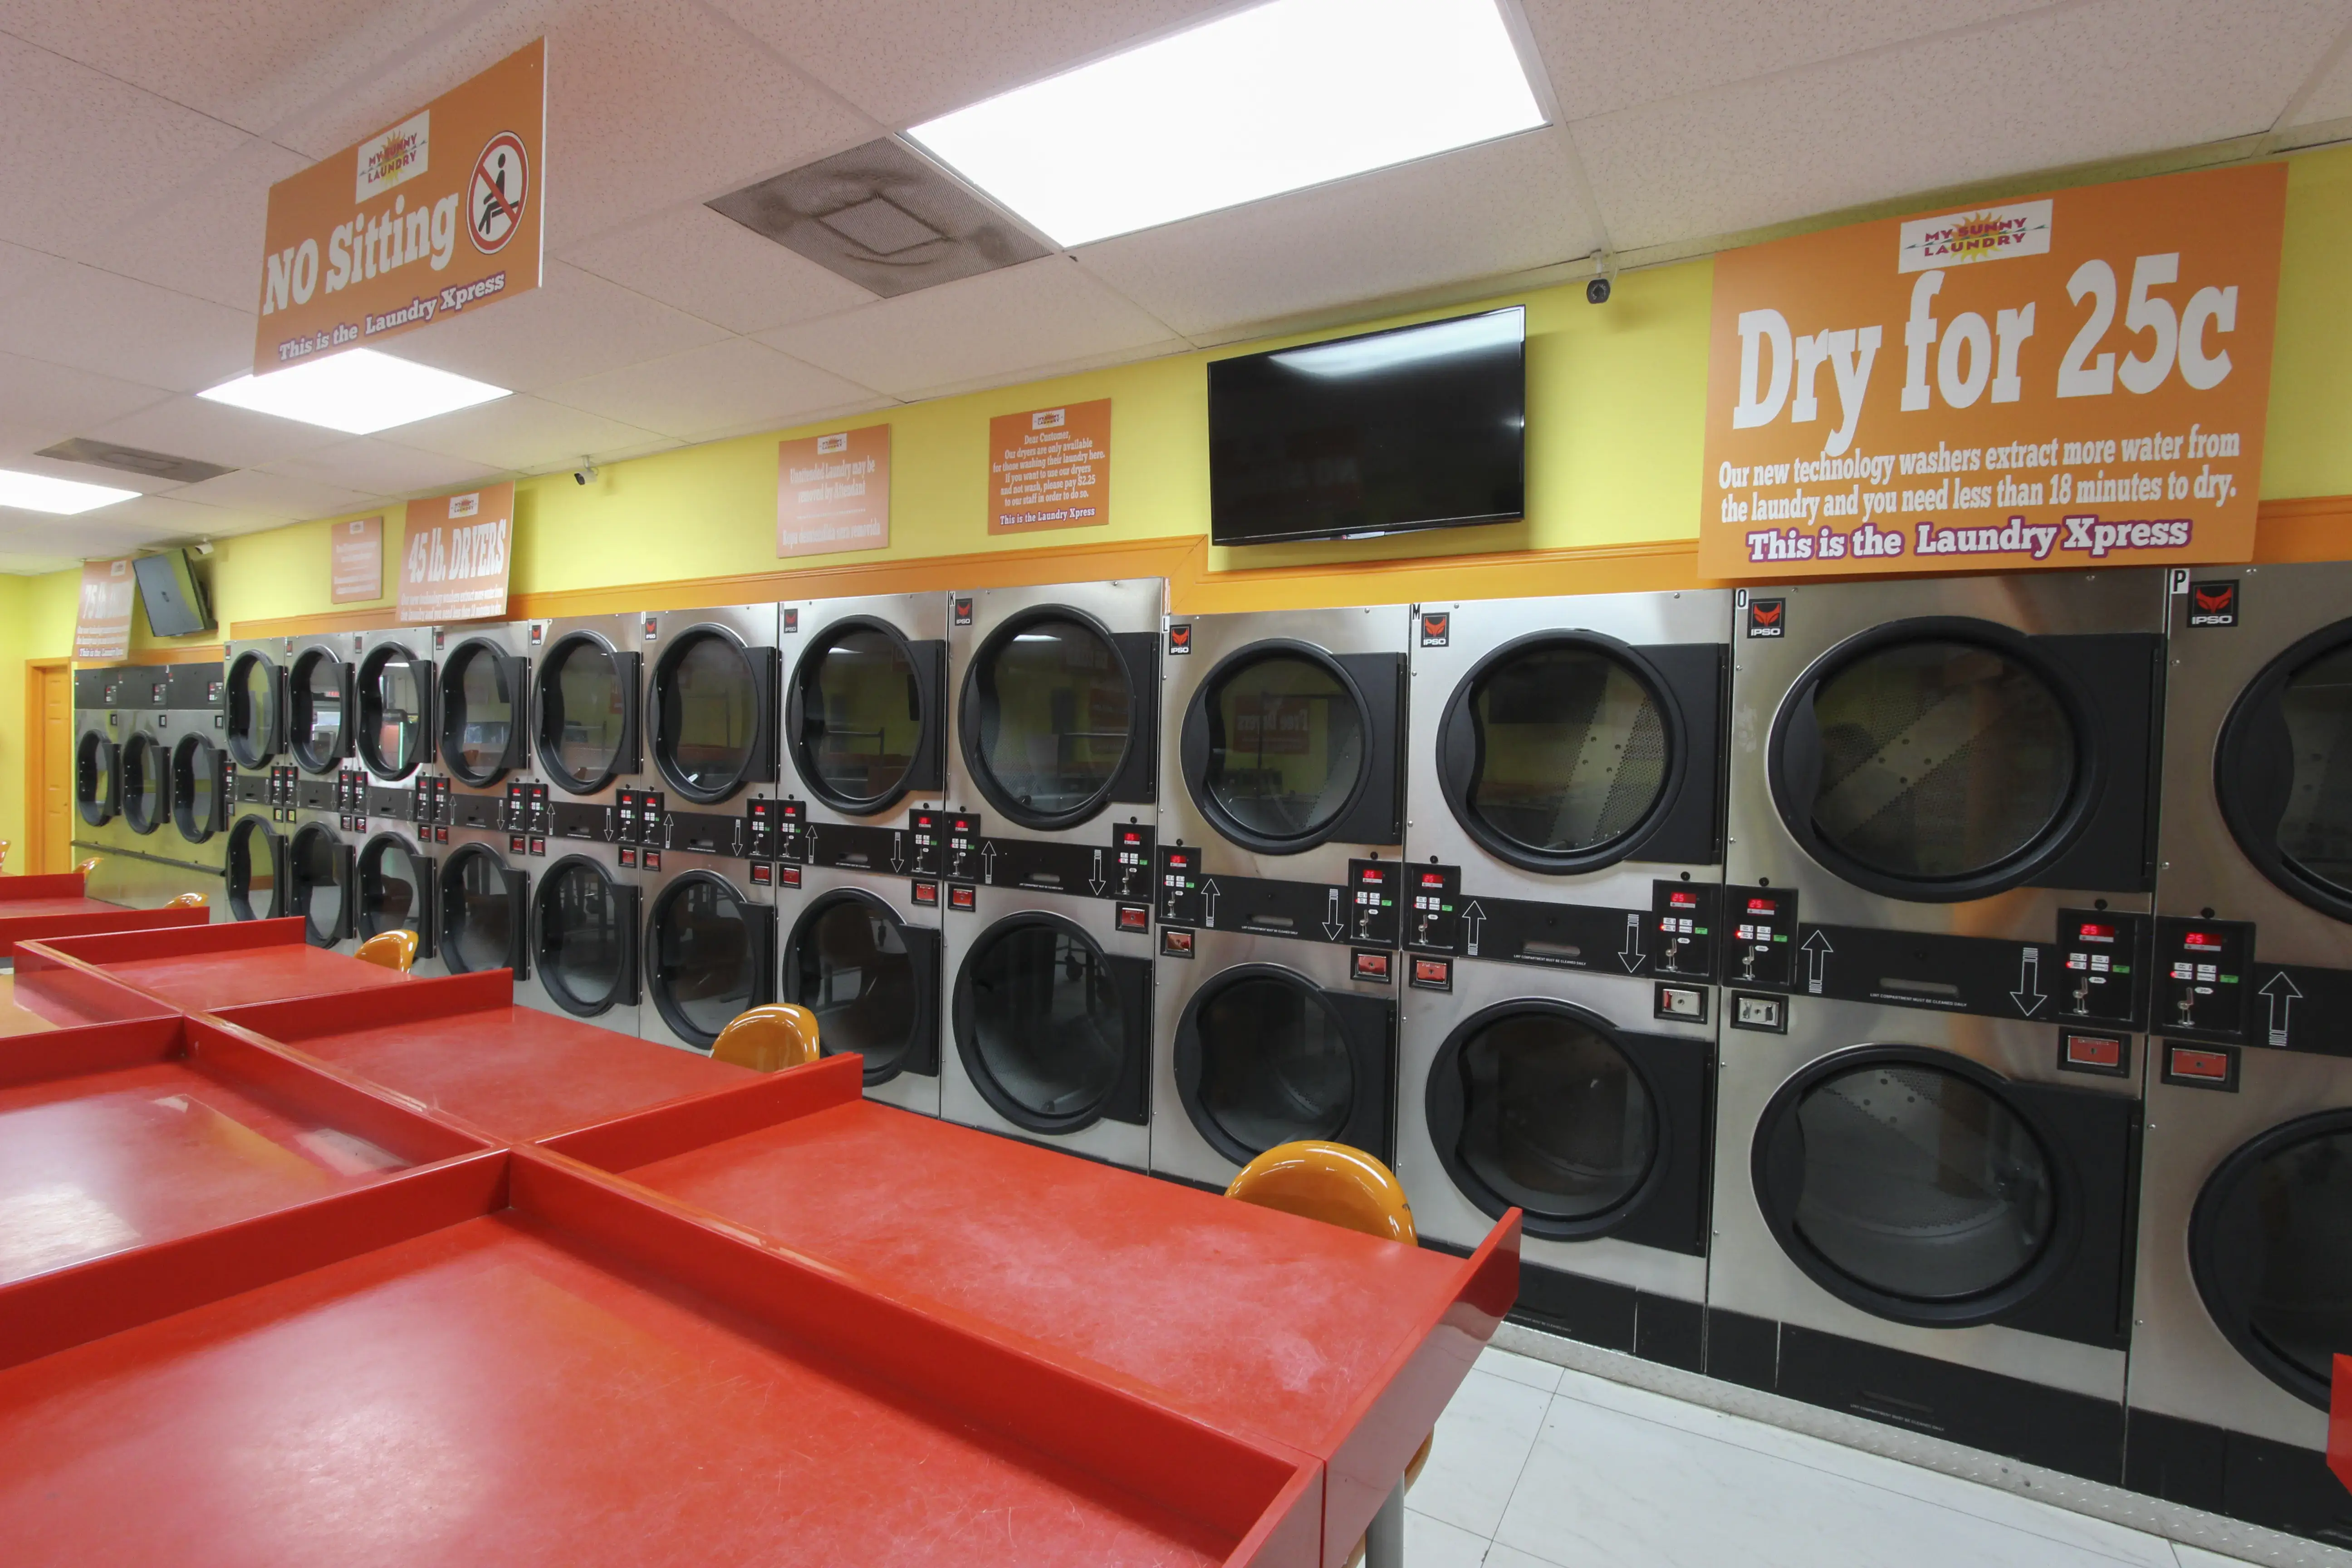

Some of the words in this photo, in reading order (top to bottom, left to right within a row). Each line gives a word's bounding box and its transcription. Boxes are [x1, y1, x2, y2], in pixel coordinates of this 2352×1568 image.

[369, 152, 382, 167] MY
[382, 133, 417, 159] SUNNY
[368, 151, 417, 183] LAUNDRY
[1925, 228, 1954, 243] MY
[1958, 217, 2027, 238] SUNNY
[263, 239, 319, 315] NO
[326, 192, 459, 294] Sitting
[1924, 232, 2027, 257] LAUNDRY
[280, 339, 312, 360] This
[317, 333, 328, 351] is
[333, 324, 358, 345] the
[366, 298, 437, 335] Laundry
[441, 272, 505, 310] Xpress
[1733, 309, 1882, 456] Dry
[1901, 271, 2035, 411] for
[1004, 450, 1015, 459] Our
[1017, 448, 1036, 460] dryers
[1037, 446, 1047, 455] are
[1048, 442, 1062, 456] only
[1063, 438, 1093, 451] available
[1024, 435, 1038, 445] Dear
[1039, 431, 1071, 442] Customer,
[825, 459, 851, 480] Laundry
[852, 461, 866, 479] may
[867, 455, 875, 473] be
[993, 463, 1001, 473] for
[1003, 460, 1019, 471] those
[1020, 456, 1046, 469] washing
[1047, 455, 1062, 466] their
[1063, 450, 1088, 464] laundry
[1089, 450, 1105, 460] here.
[1719, 461, 1749, 489] Our
[1753, 461, 1790, 486] new
[1794, 448, 1895, 485] technology
[1900, 441, 1981, 475] washers
[1985, 438, 2058, 470] extract
[2063, 438, 2116, 465] more
[2122, 431, 2183, 462] water
[2187, 424, 2239, 459] from
[1000, 485, 1012, 495] and
[1013, 484, 1023, 494] not
[1024, 481, 1043, 493] wash,
[1044, 479, 1063, 493] please
[1064, 478, 1076, 489] pay
[1078, 475, 1096, 486] $2.25
[1005, 473, 1011, 483] If
[1011, 474, 1022, 485] you
[1024, 470, 1039, 480] want
[1047, 469, 1058, 477] use
[1059, 467, 1069, 475] our
[1071, 463, 1091, 476] dryers
[825, 483, 833, 505] by
[1004, 498, 1011, 507] to
[1012, 497, 1022, 506] our
[1023, 493, 1037, 504] staff
[1038, 492, 1044, 502] in
[1045, 491, 1062, 502] order
[1063, 491, 1069, 499] to
[1070, 490, 1078, 499] do
[1721, 494, 1747, 523] the
[1751, 488, 1820, 526] laundry
[1824, 484, 1859, 516] and
[1862, 492, 1896, 522] you
[1901, 478, 1949, 511] need
[1953, 478, 1991, 510] less
[1997, 475, 2042, 507] than
[2049, 473, 2072, 505] 18
[2076, 470, 2162, 504] minutes
[2168, 471, 2188, 494] to
[2194, 464, 2236, 508] dry.
[1000, 515, 1015, 525] This
[1017, 514, 1023, 523] is
[1025, 512, 1036, 523] the
[1038, 509, 1068, 521] Laundry
[1069, 507, 1095, 519] Xpress
[1749, 530, 1812, 560] This
[1818, 529, 1845, 558] is
[1851, 526, 1901, 556] the
[1917, 518, 2057, 558] Laundry
[2063, 518, 2188, 555] Xpress
[408, 533, 428, 583] 45
[449, 519, 506, 580] DRYERS
[2173, 570, 2186, 592] P
[950, 593, 955, 605] K
[1412, 603, 1420, 620] M
[2191, 615, 2232, 625] IPSO
[1163, 617, 1168, 632] L
[1750, 628, 1780, 636] IPSO
[1672, 894, 1684, 902] 25
[2081, 925, 2097, 935] 25
[2185, 934, 2203, 944] 25
